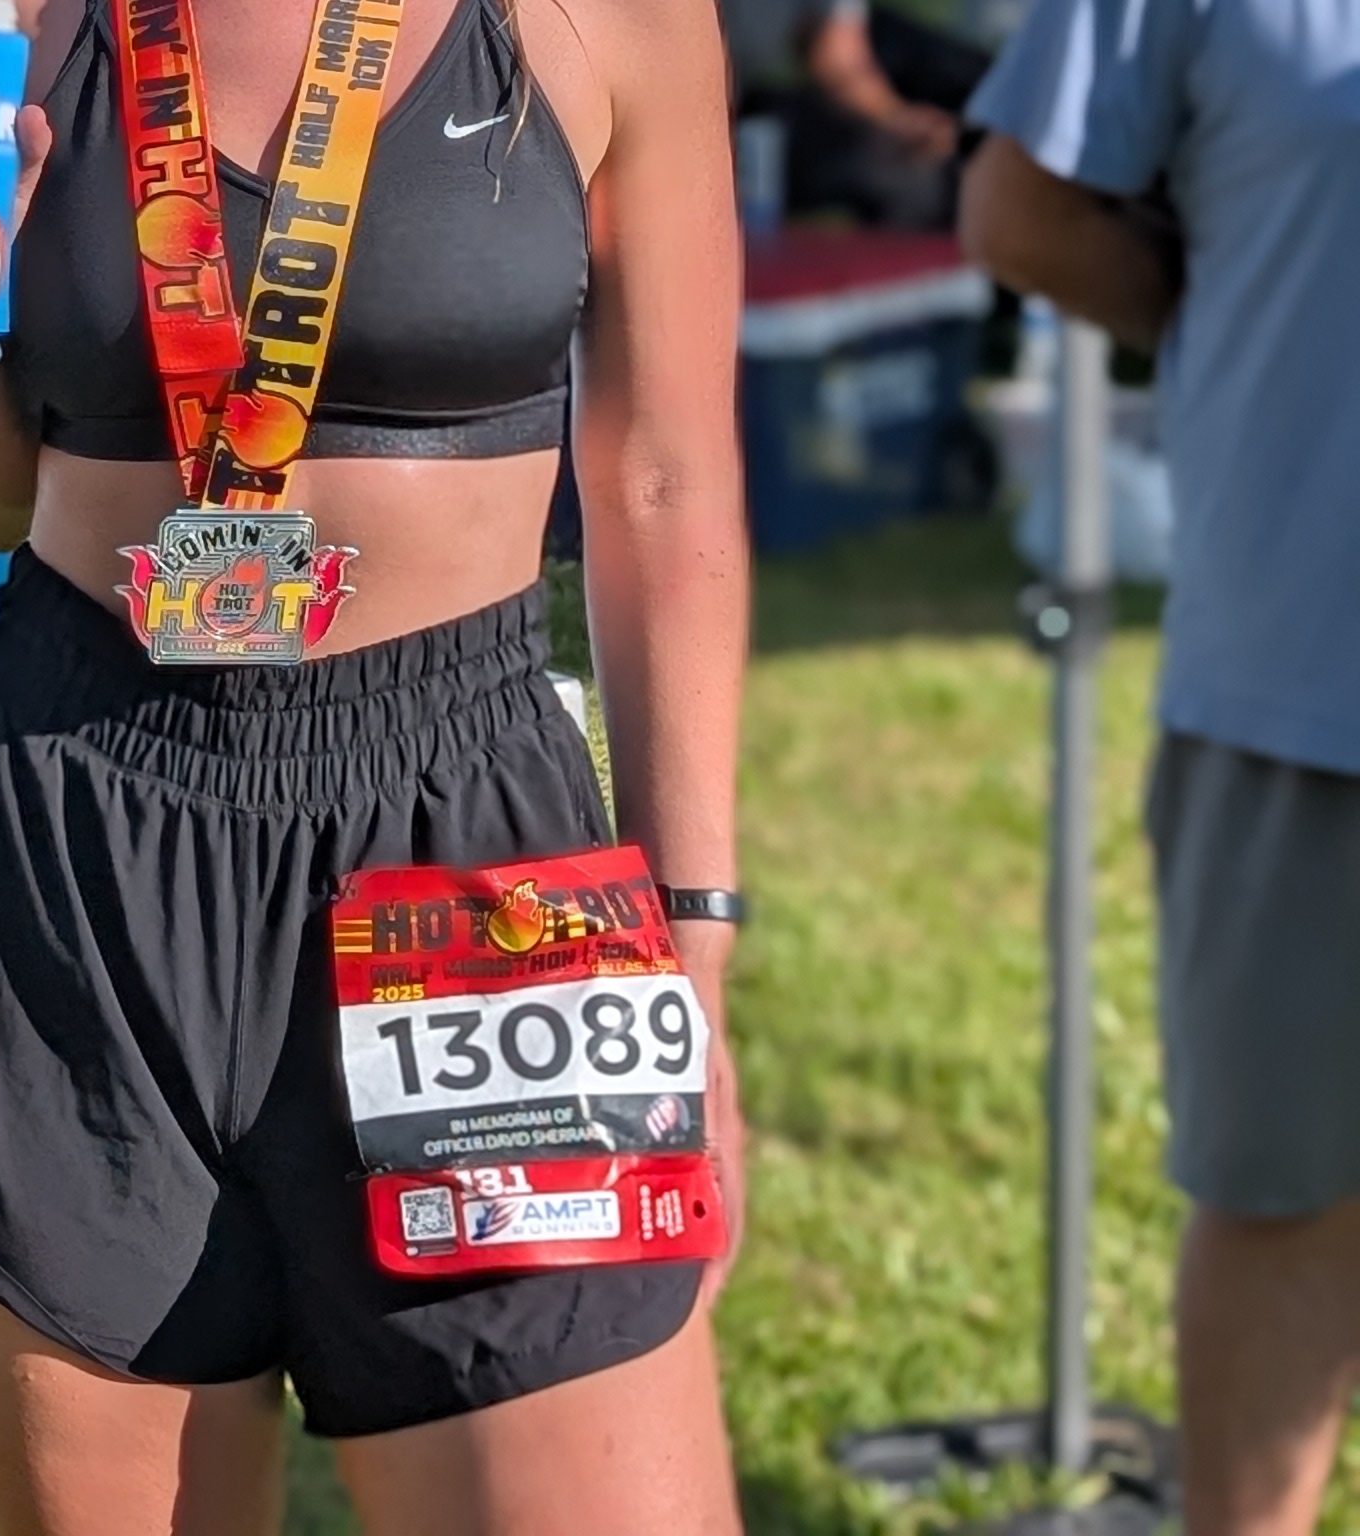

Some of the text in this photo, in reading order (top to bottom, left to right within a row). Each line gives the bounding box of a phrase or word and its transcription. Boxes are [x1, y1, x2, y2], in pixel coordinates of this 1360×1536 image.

[347, 36, 395, 93] 10K
[135, 72, 193, 132] IN
[289, 81, 341, 170] HALF
[280, 538, 312, 574] IN
[371, 983, 425, 1003] 2025
[375, 989, 694, 1098] 13089
[449, 1106, 575, 1135] IN MEMORIAM OF
[484, 1131, 531, 1151] DAVID
[454, 1165, 533, 1200] 13.1
[521, 1197, 613, 1221] AMPT
[511, 1221, 614, 1236] RUNNING
